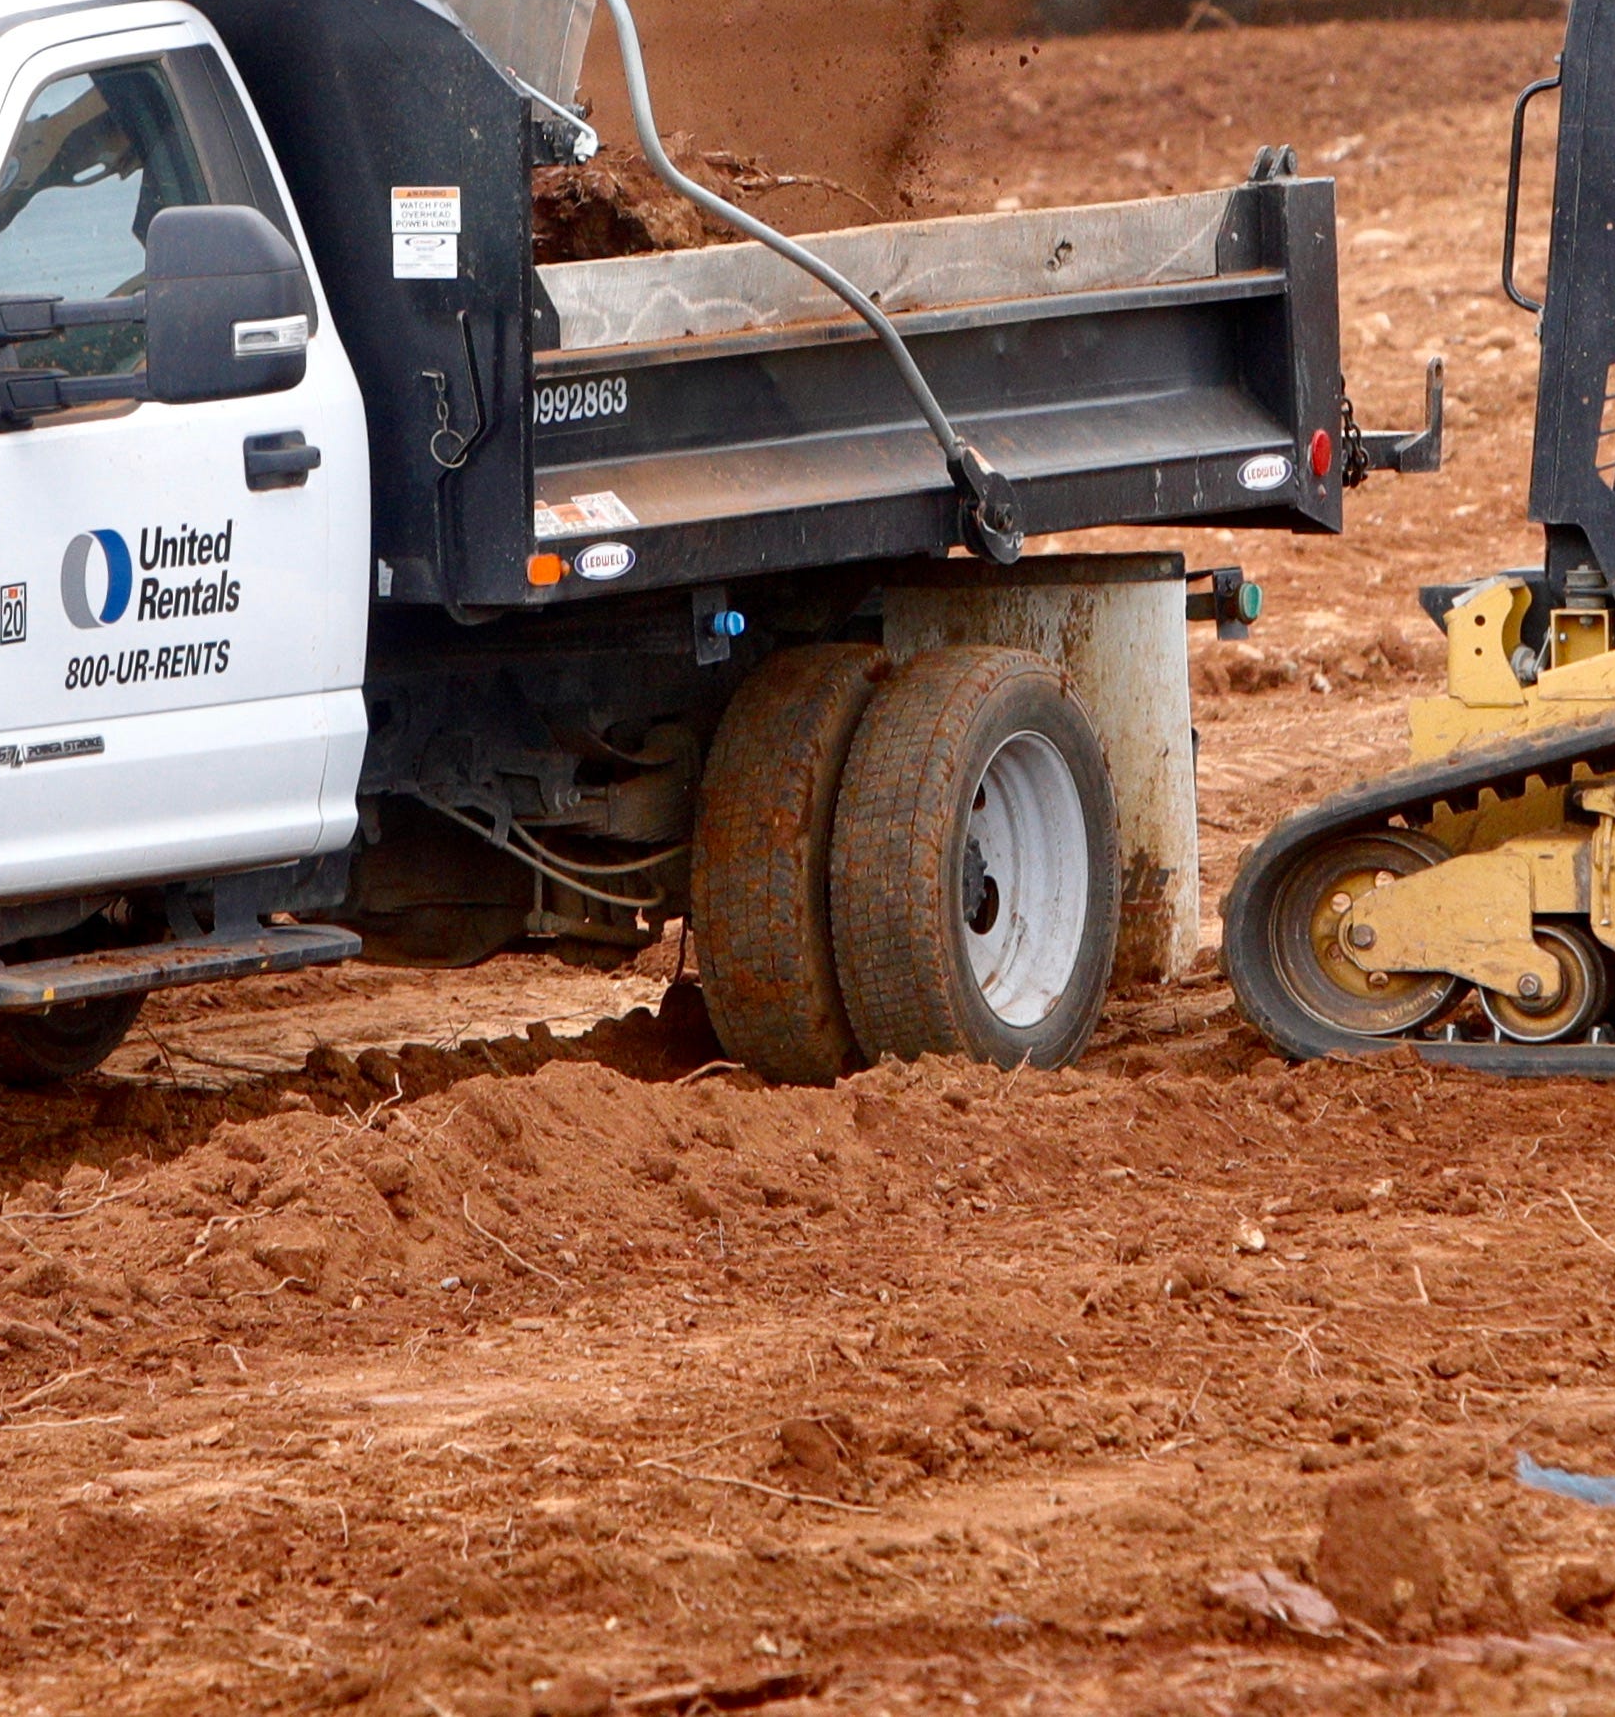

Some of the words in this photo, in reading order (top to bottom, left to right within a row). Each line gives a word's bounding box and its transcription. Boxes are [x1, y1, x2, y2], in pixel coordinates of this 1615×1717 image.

[399, 201, 431, 209] WATCH
[433, 201, 452, 209] FOR
[401, 210, 451, 219] OVERHEAD
[395, 219, 428, 228] POWER
[430, 219, 457, 228] LINES
[139, 519, 233, 571] United
[585, 553, 625, 569] LEDWELL
[137, 569, 241, 622] Rentals
[2, 600, 24, 638] 20
[65, 639, 231, 690] 800-UR-RENTS
